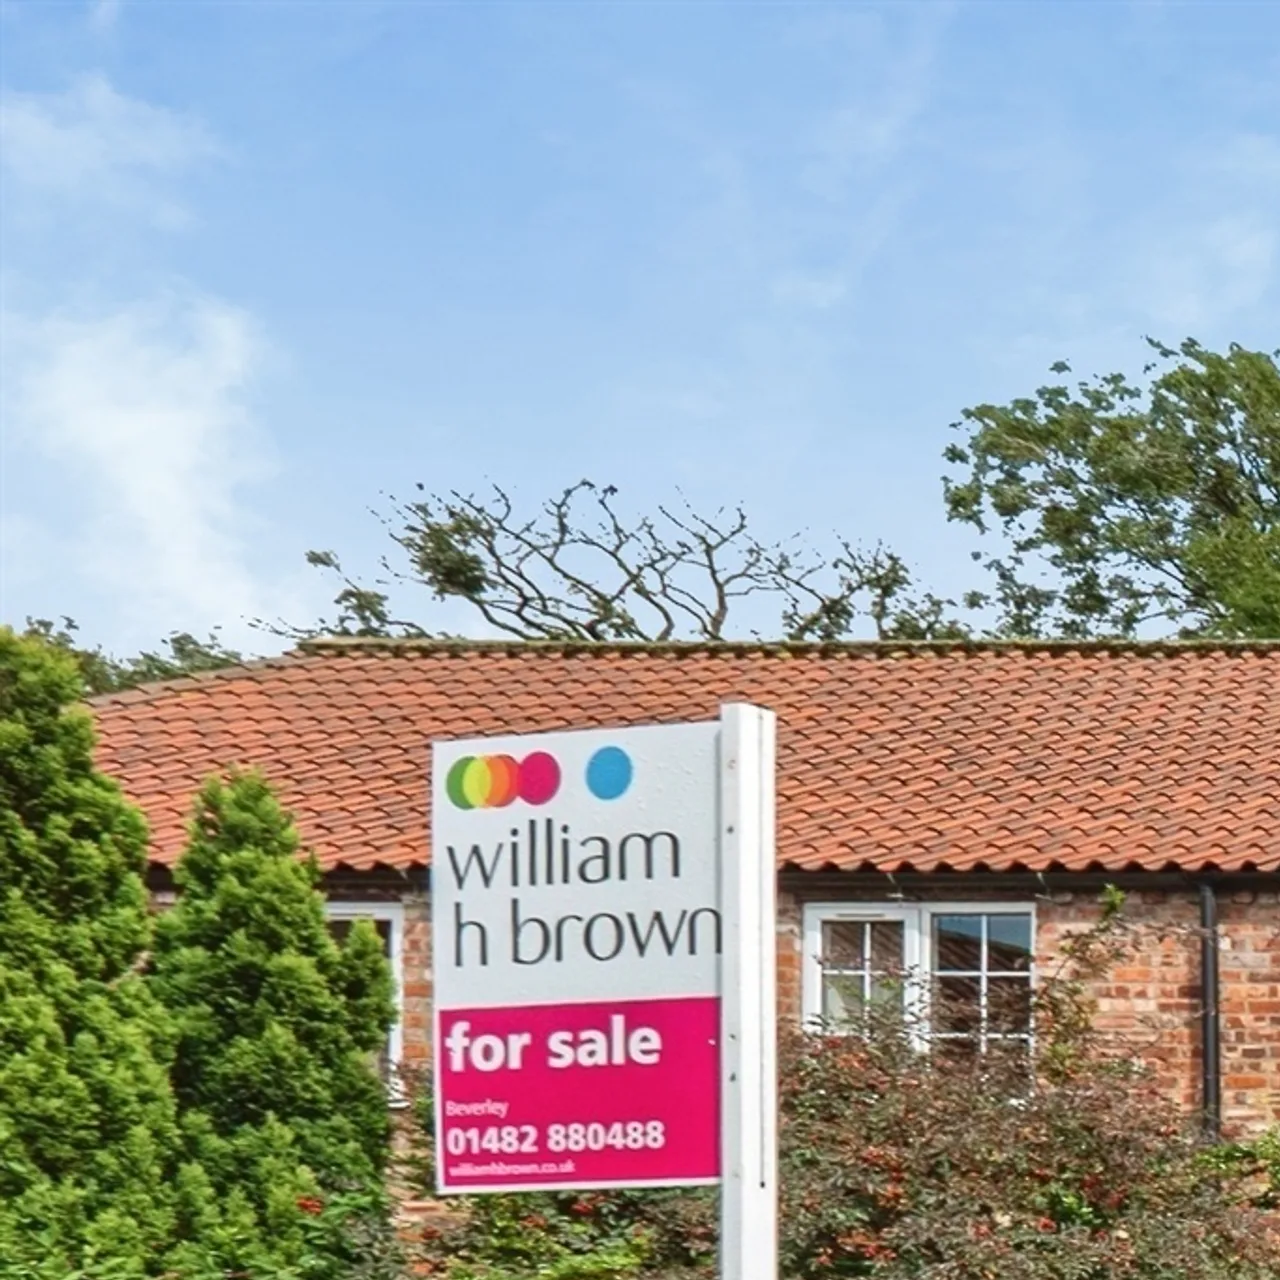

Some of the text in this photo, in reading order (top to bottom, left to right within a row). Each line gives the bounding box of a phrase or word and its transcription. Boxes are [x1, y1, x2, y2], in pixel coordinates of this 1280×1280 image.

[446, 817, 680, 890] william
[454, 897, 723, 967] h brown
[445, 1014, 662, 1072] for sale
[445, 1099, 509, 1119] Beverley
[447, 1120, 665, 1156] 01482 880488
